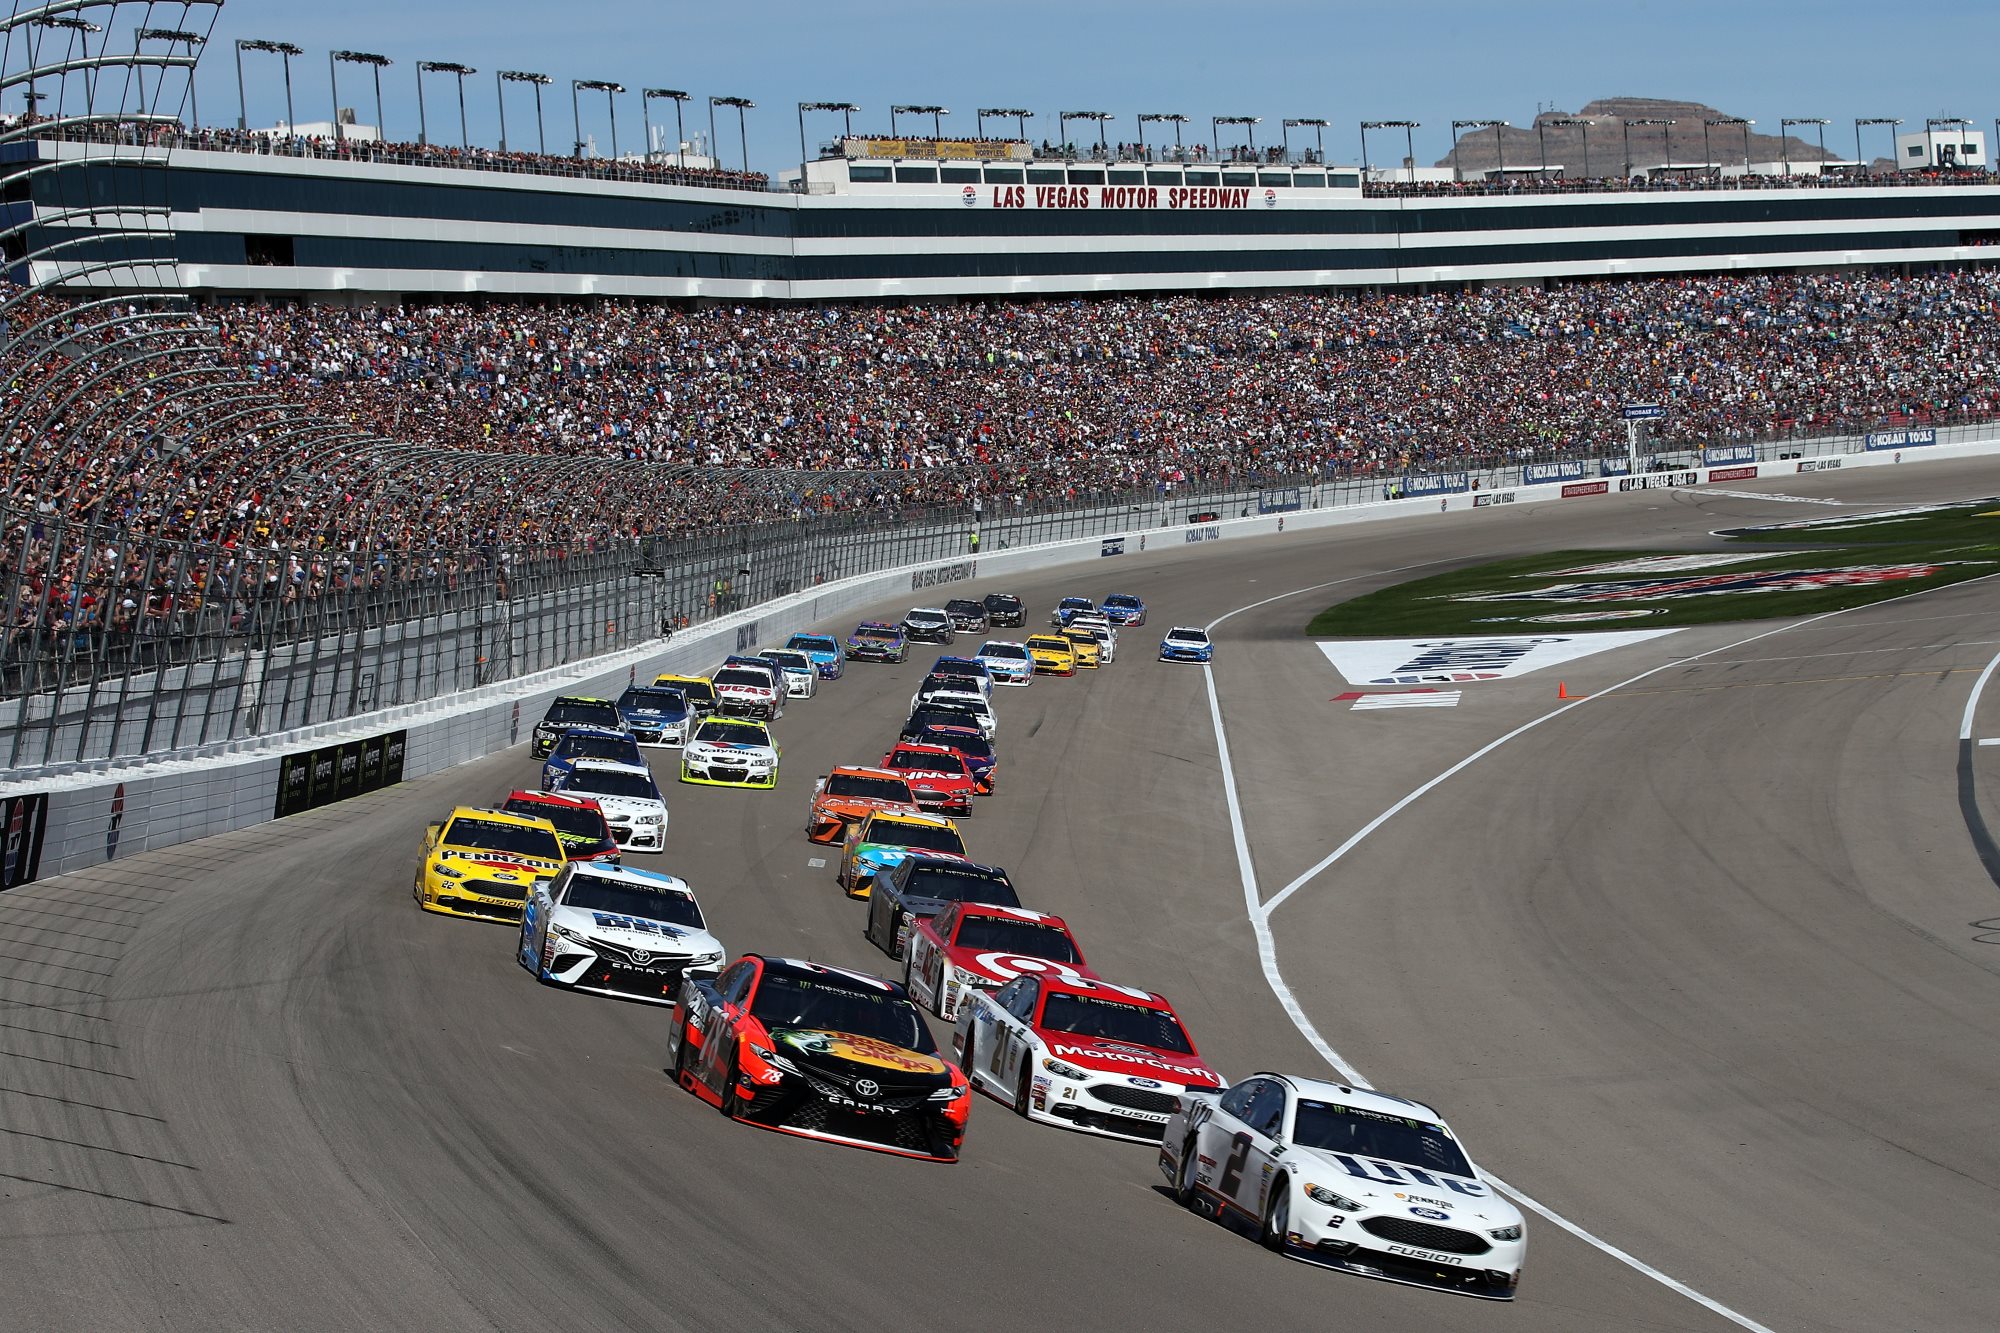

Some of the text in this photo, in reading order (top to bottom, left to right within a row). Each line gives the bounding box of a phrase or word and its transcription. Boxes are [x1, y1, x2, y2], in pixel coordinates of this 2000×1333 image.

[993, 186, 1250, 209] LAS VEGAS MOTOR SPEEDWAY
[1909, 430, 1932, 443] TOOLS
[1735, 446, 1752, 459] TOOLS
[1561, 462, 1581, 476] TOOLS
[1443, 473, 1465, 489] TOOLS
[1629, 477, 1644, 490] LAS
[1205, 526, 1220, 540] TOOLS
[717, 685, 772, 696] UCAS
[698, 747, 762, 758] Valvoline
[441, 849, 561, 869] PENNZOIL
[441, 880, 455, 890] 22
[556, 942, 570, 953] 20
[612, 962, 668, 975] CAMRY
[814, 984, 868, 999] MONSTER
[851, 1050, 934, 1073] Shops
[1053, 1044, 1218, 1084] Motorcraft
[761, 1068, 784, 1083] 78
[1133, 1078, 1156, 1088] Ford
[1062, 1086, 1078, 1101] 21
[828, 1096, 900, 1115] CAMRY
[1349, 1108, 1404, 1124] MONSTER
[1218, 1131, 1254, 1200] 2
[1408, 1194, 1455, 1210] PENNZOIL
[1415, 1206, 1444, 1219] Ford
[1327, 1214, 1345, 1229] 2
[1387, 1245, 1463, 1265] FUSION
